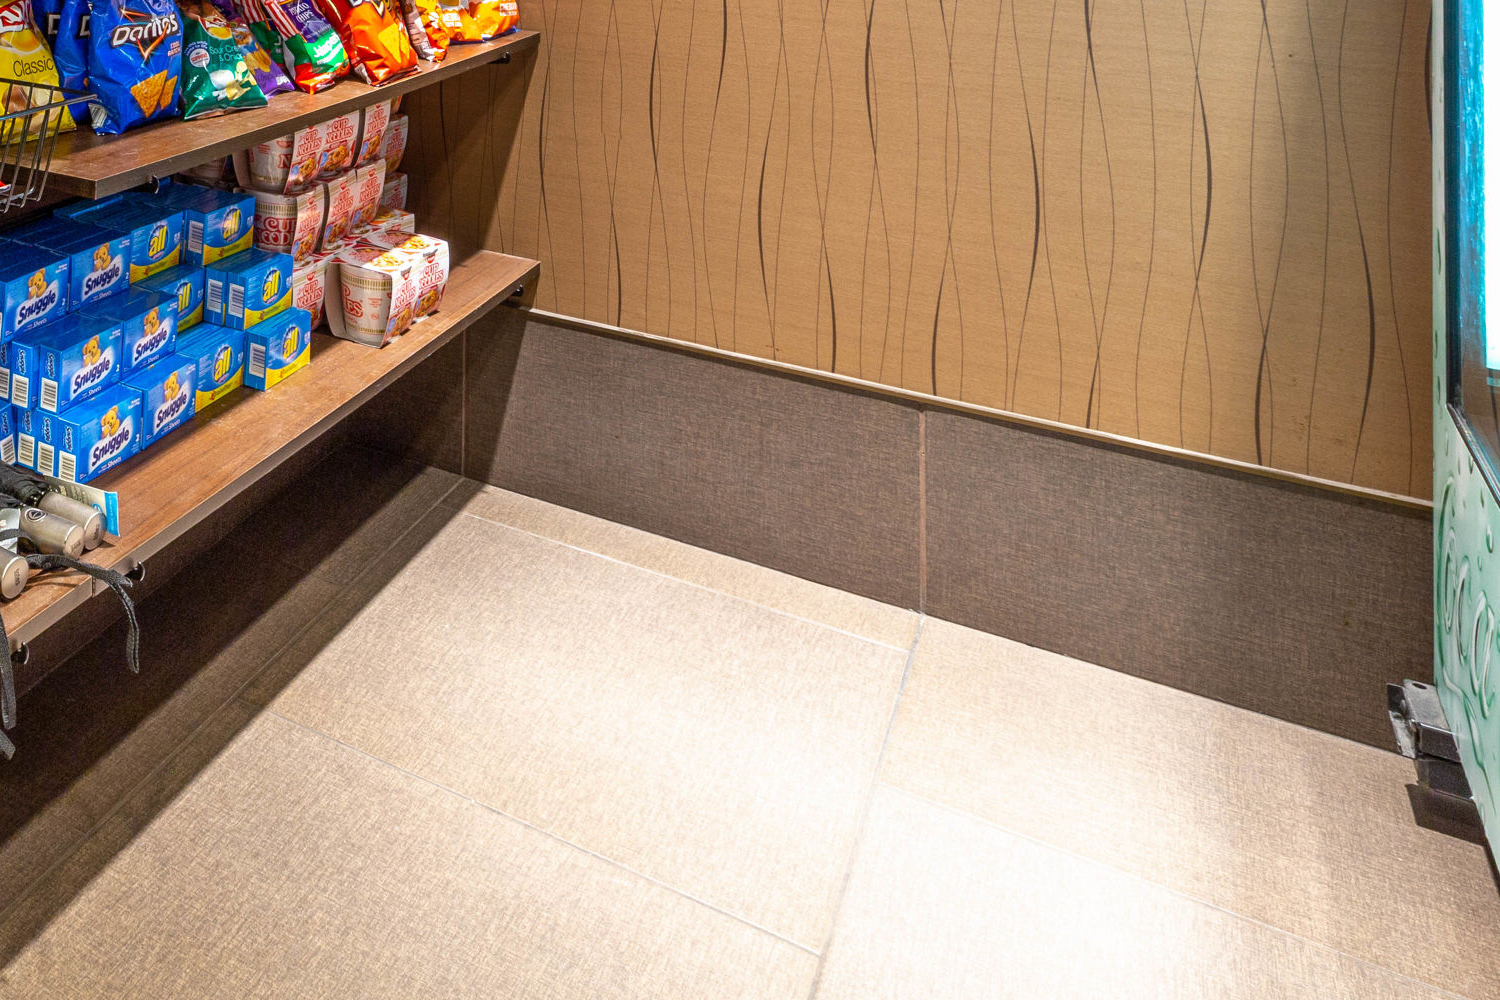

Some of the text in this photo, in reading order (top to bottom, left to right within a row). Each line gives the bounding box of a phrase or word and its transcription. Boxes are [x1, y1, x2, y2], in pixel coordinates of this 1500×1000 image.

[112, 13, 180, 47] Doritos
[12, 56, 55, 78] Classic
[331, 117, 349, 132] CUP
[149, 225, 167, 259] all
[222, 209, 241, 241] all
[84, 263, 121, 297] Snuggle
[262, 269, 281, 304] all
[425, 262, 440, 279] CUP
[304, 280, 319, 296] CUP
[18, 288, 57, 326] Snuggle
[134, 328, 168, 362] Snuggle
[283, 327, 299, 361] all
[73, 358, 111, 395] Snuggle
[214, 346, 232, 382] all
[88, 386, 102, 397] Sheets
[156, 391, 188, 429] Snuggle
[92, 428, 131, 466] Snuggle
[107, 456, 122, 468] Sheets
